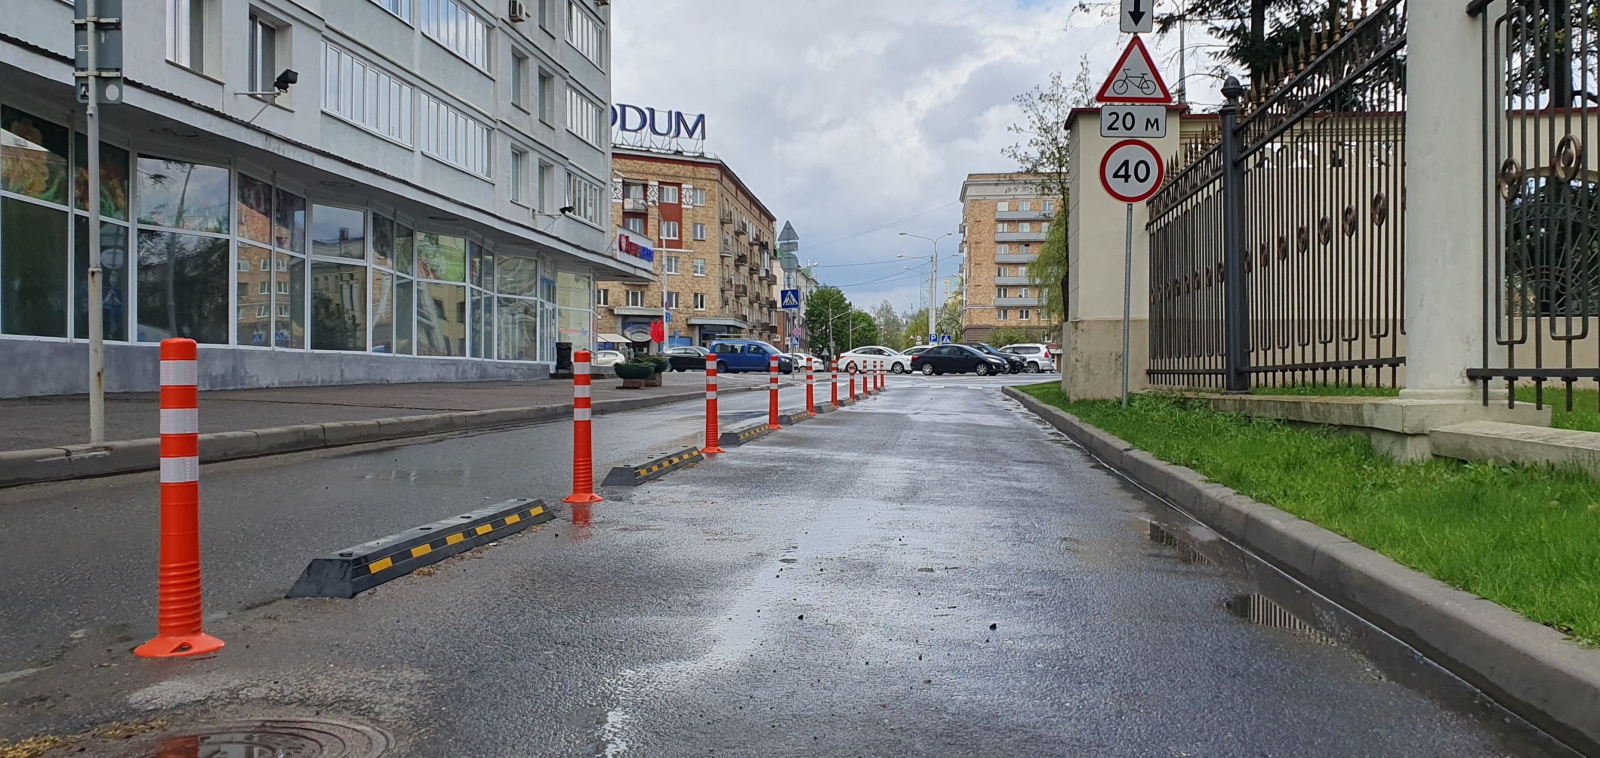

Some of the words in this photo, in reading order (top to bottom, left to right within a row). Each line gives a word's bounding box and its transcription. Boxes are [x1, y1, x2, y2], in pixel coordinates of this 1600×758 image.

[611, 103, 706, 140] DUM
[1107, 111, 1136, 131] 20
[1112, 159, 1151, 183] 40
